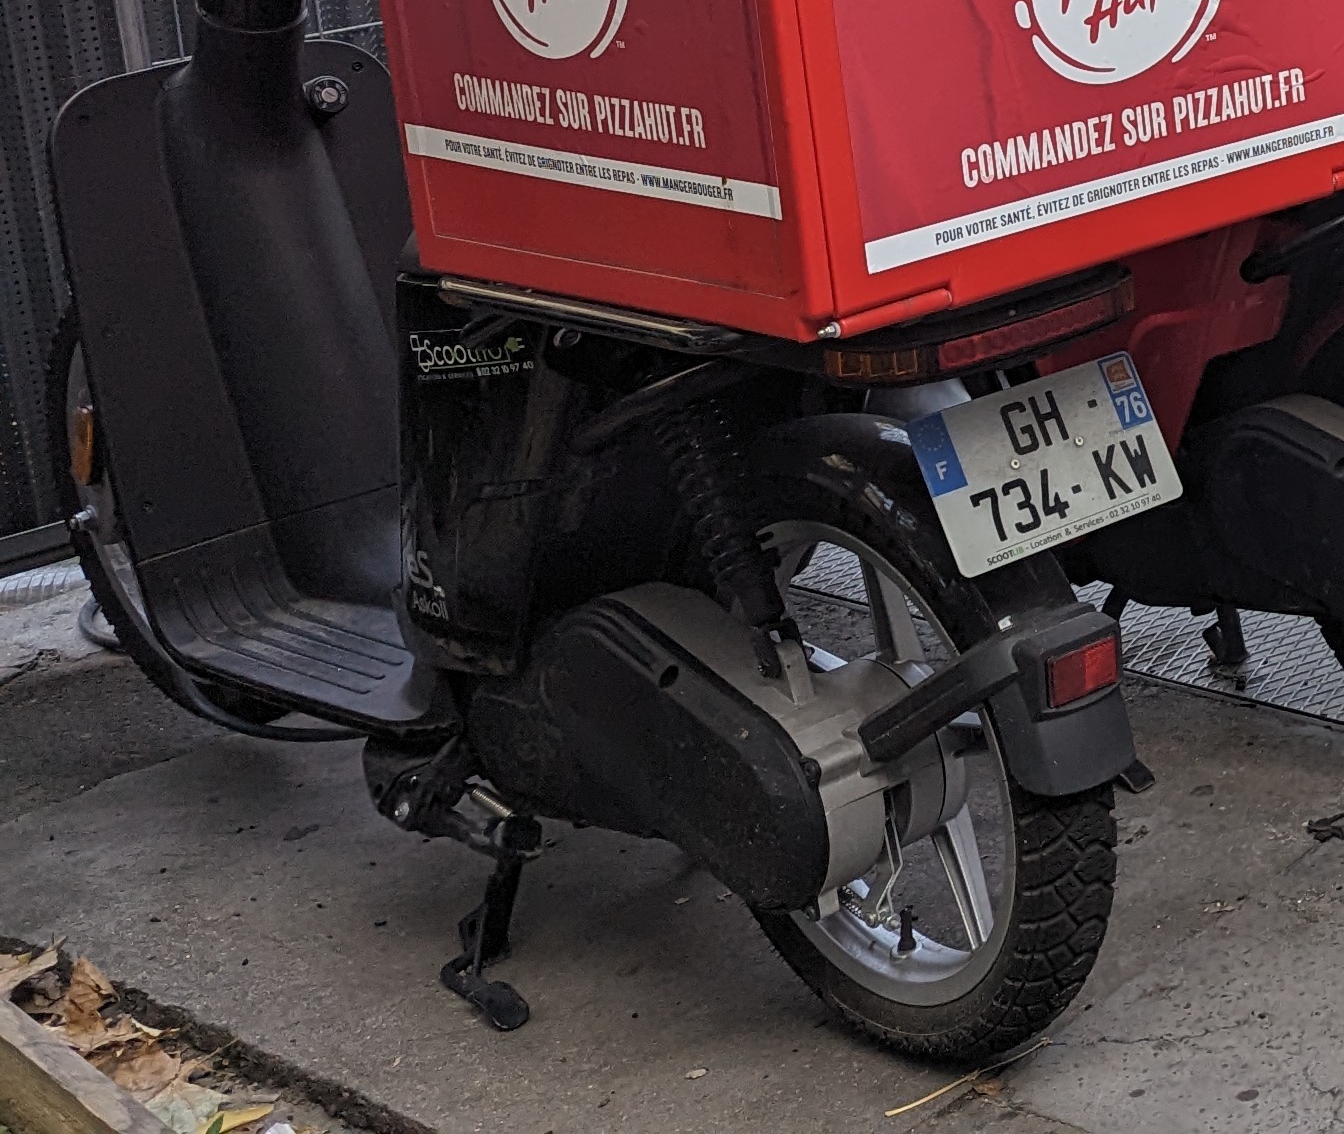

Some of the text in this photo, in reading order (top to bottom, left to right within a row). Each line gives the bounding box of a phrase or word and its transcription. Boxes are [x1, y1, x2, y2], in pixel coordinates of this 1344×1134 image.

[453, 72, 707, 149] COMMANDEZ SUR PIZZAHUT.FR
[961, 67, 1306, 188] COMMANDEZ SUR PIZZAHUT.FR
[935, 226, 964, 246] POUR
[965, 217, 999, 237] VOTRE
[1000, 205, 1036, 227] SANTÉ,
[1036, 197, 1071, 218] ÉVITEZ
[1072, 193, 1086, 207] DE
[1087, 177, 1141, 203] GRIGNOTER
[1142, 169, 1172, 188] ENTRE
[1172, 163, 1190, 180] LES
[1191, 156, 1220, 174] REPAS
[1226, 125, 1335, 164] WWW.MANGERBOUGER.FR
[1114, 391, 1148, 424] 76
[935, 460, 948, 481] F
[1030, 531, 1063, 550] Location
[1064, 527, 1072, 537] &
[1073, 516, 1105, 535] Services
[1109, 509, 1120, 519] 02
[1120, 504, 1130, 515] 32
[1131, 501, 1141, 511] 10
[1141, 497, 1152, 507] 97
[1152, 493, 1162, 503] 40
